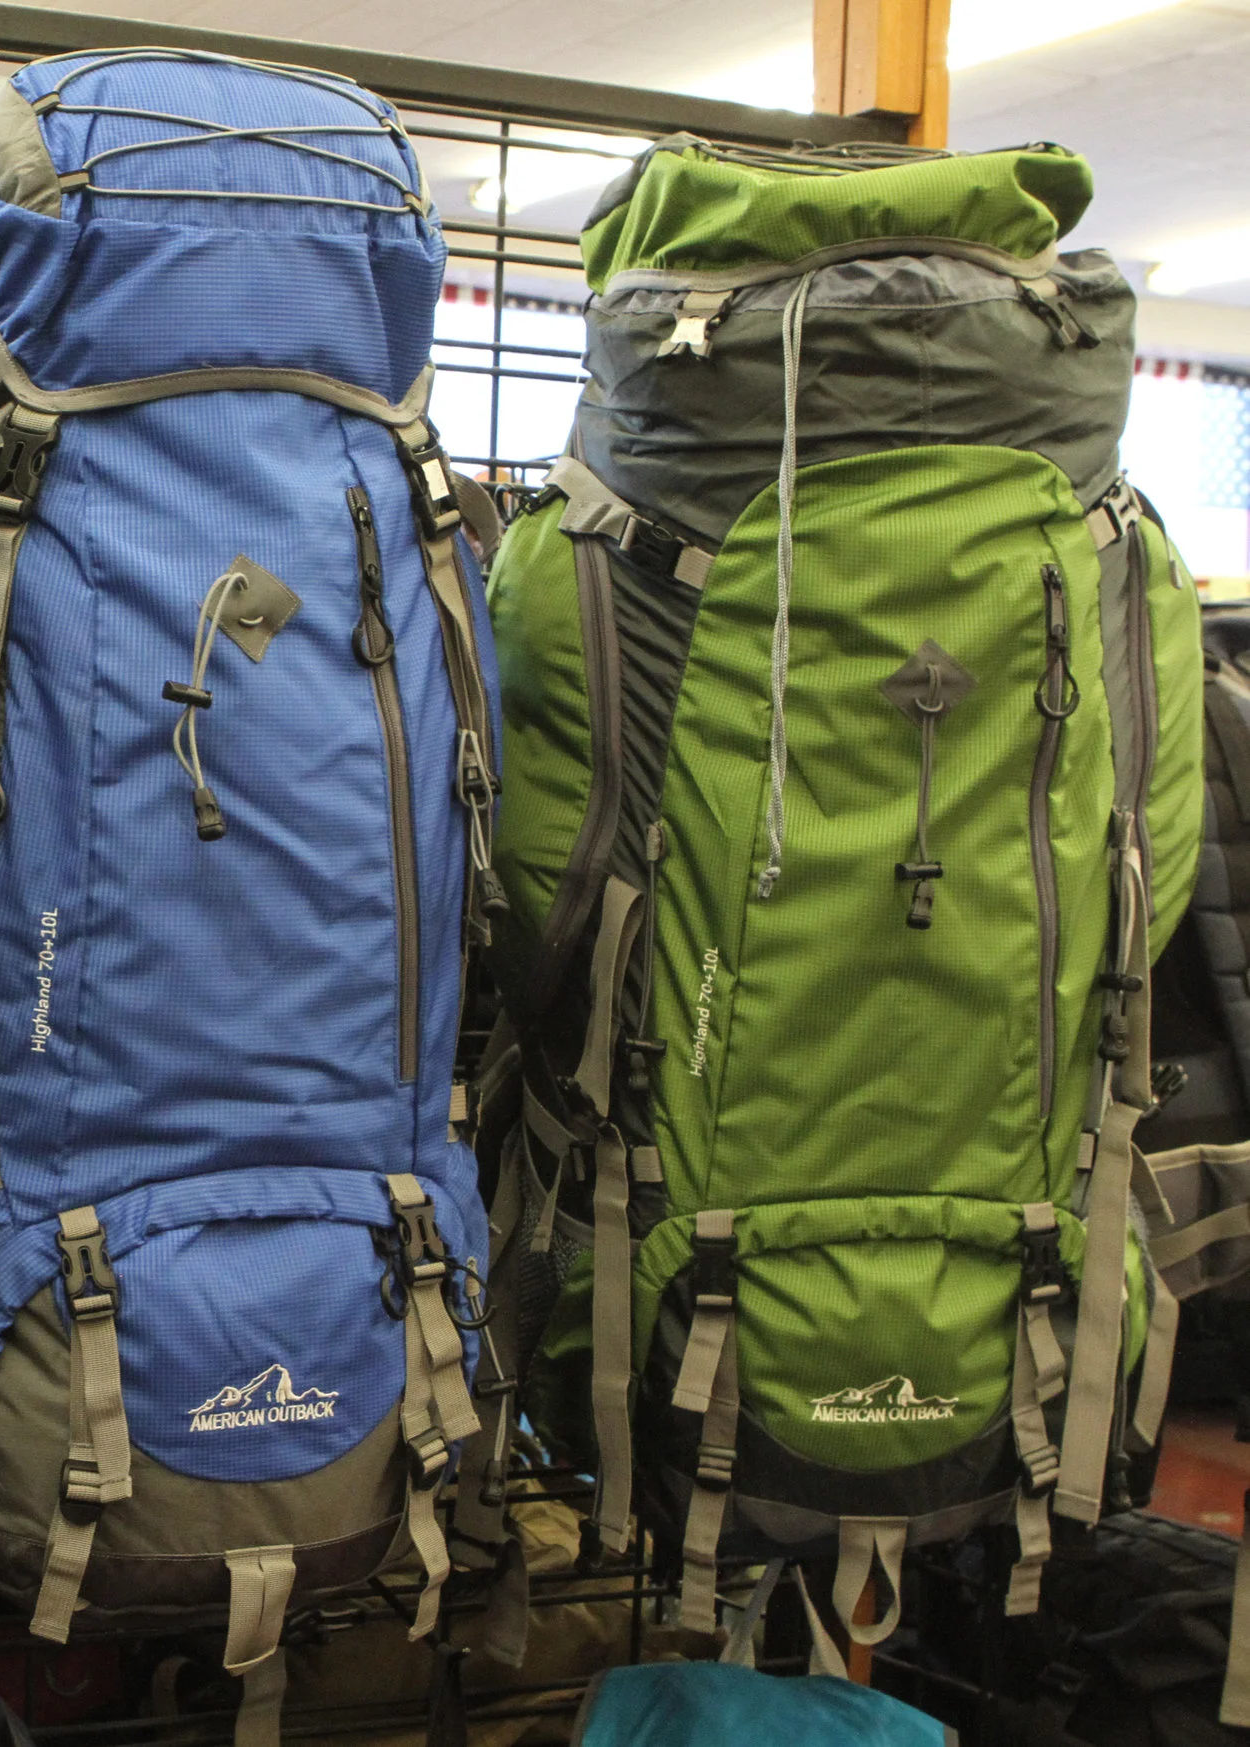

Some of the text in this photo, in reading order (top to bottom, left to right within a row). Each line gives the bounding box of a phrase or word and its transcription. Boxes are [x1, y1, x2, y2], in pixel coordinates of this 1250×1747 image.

[31, 907, 59, 1053] Highland 70+10L
[690, 946, 719, 1077] Highland 70+10L
[189, 1400, 336, 1433] AMERICAN OUTBACK
[811, 1403, 956, 1423] AMERICAN OUTBACK
